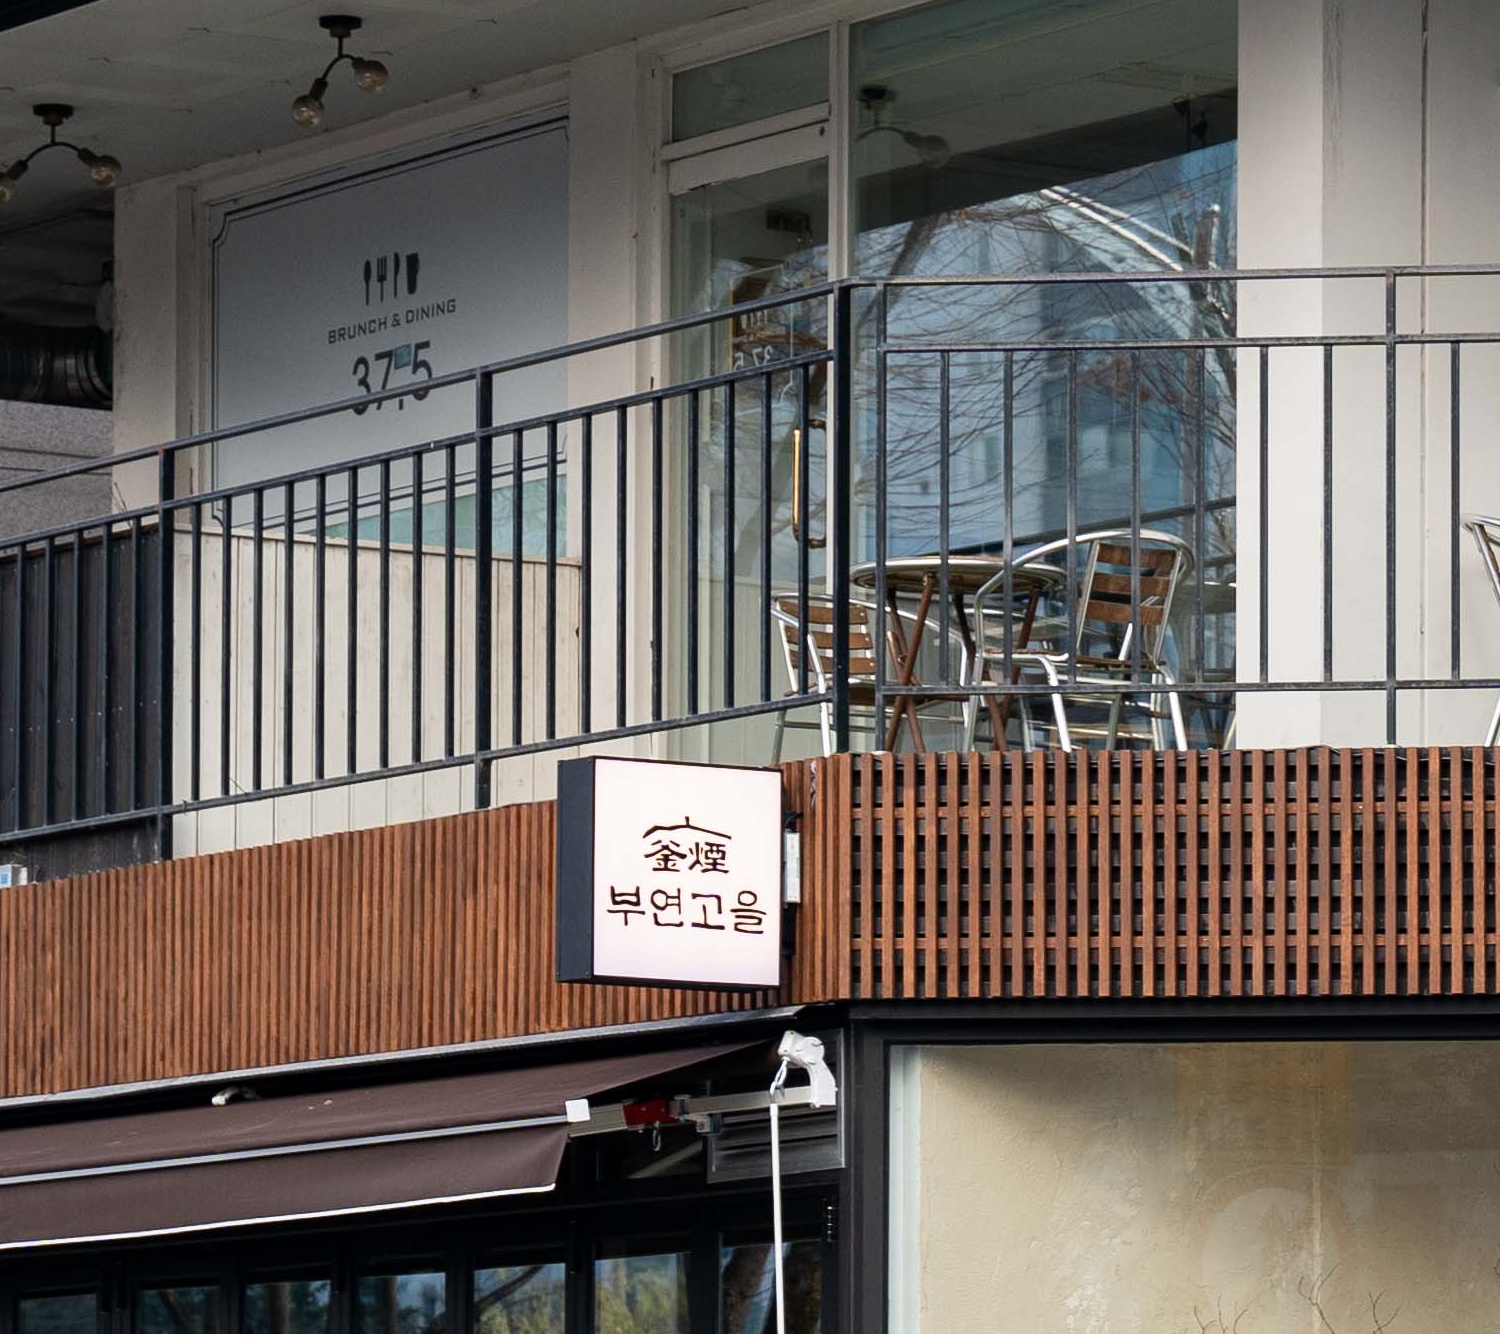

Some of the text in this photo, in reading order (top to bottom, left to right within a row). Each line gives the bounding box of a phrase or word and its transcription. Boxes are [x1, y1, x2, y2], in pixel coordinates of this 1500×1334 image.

[328, 298, 457, 344] BRUNCH & DINING
[644, 839, 729, 874] 釜煙
[606, 885, 767, 935] 부연고을
